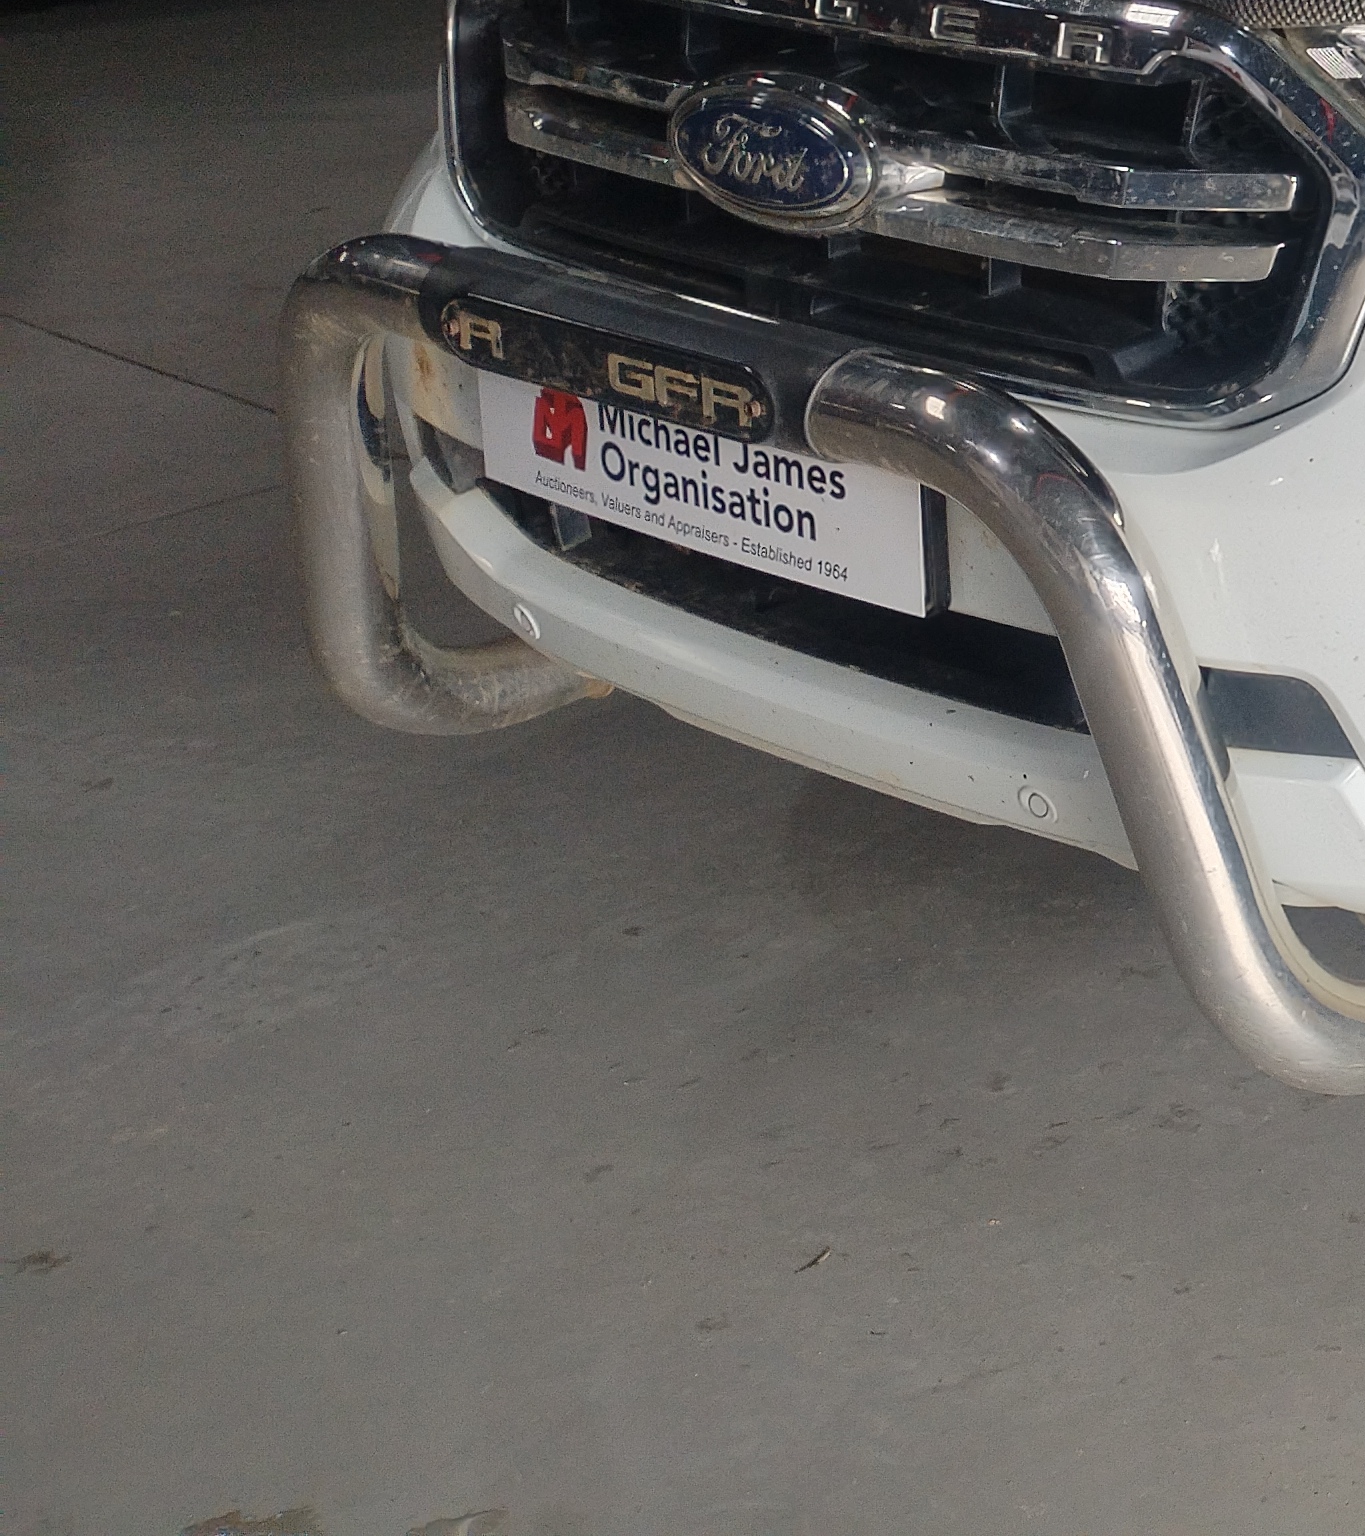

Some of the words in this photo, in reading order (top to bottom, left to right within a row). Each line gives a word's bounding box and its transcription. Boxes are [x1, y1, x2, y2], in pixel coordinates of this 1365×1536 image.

[703, 113, 808, 192] Ford
[597, 402, 721, 466] Michael
[732, 443, 847, 499] James
[600, 440, 818, 541] Organisation
[601, 492, 642, 519] Valuers
[644, 508, 666, 528] and
[667, 515, 730, 548] Appraisers
[741, 536, 812, 571] Established
[816, 559, 849, 583] 1964
